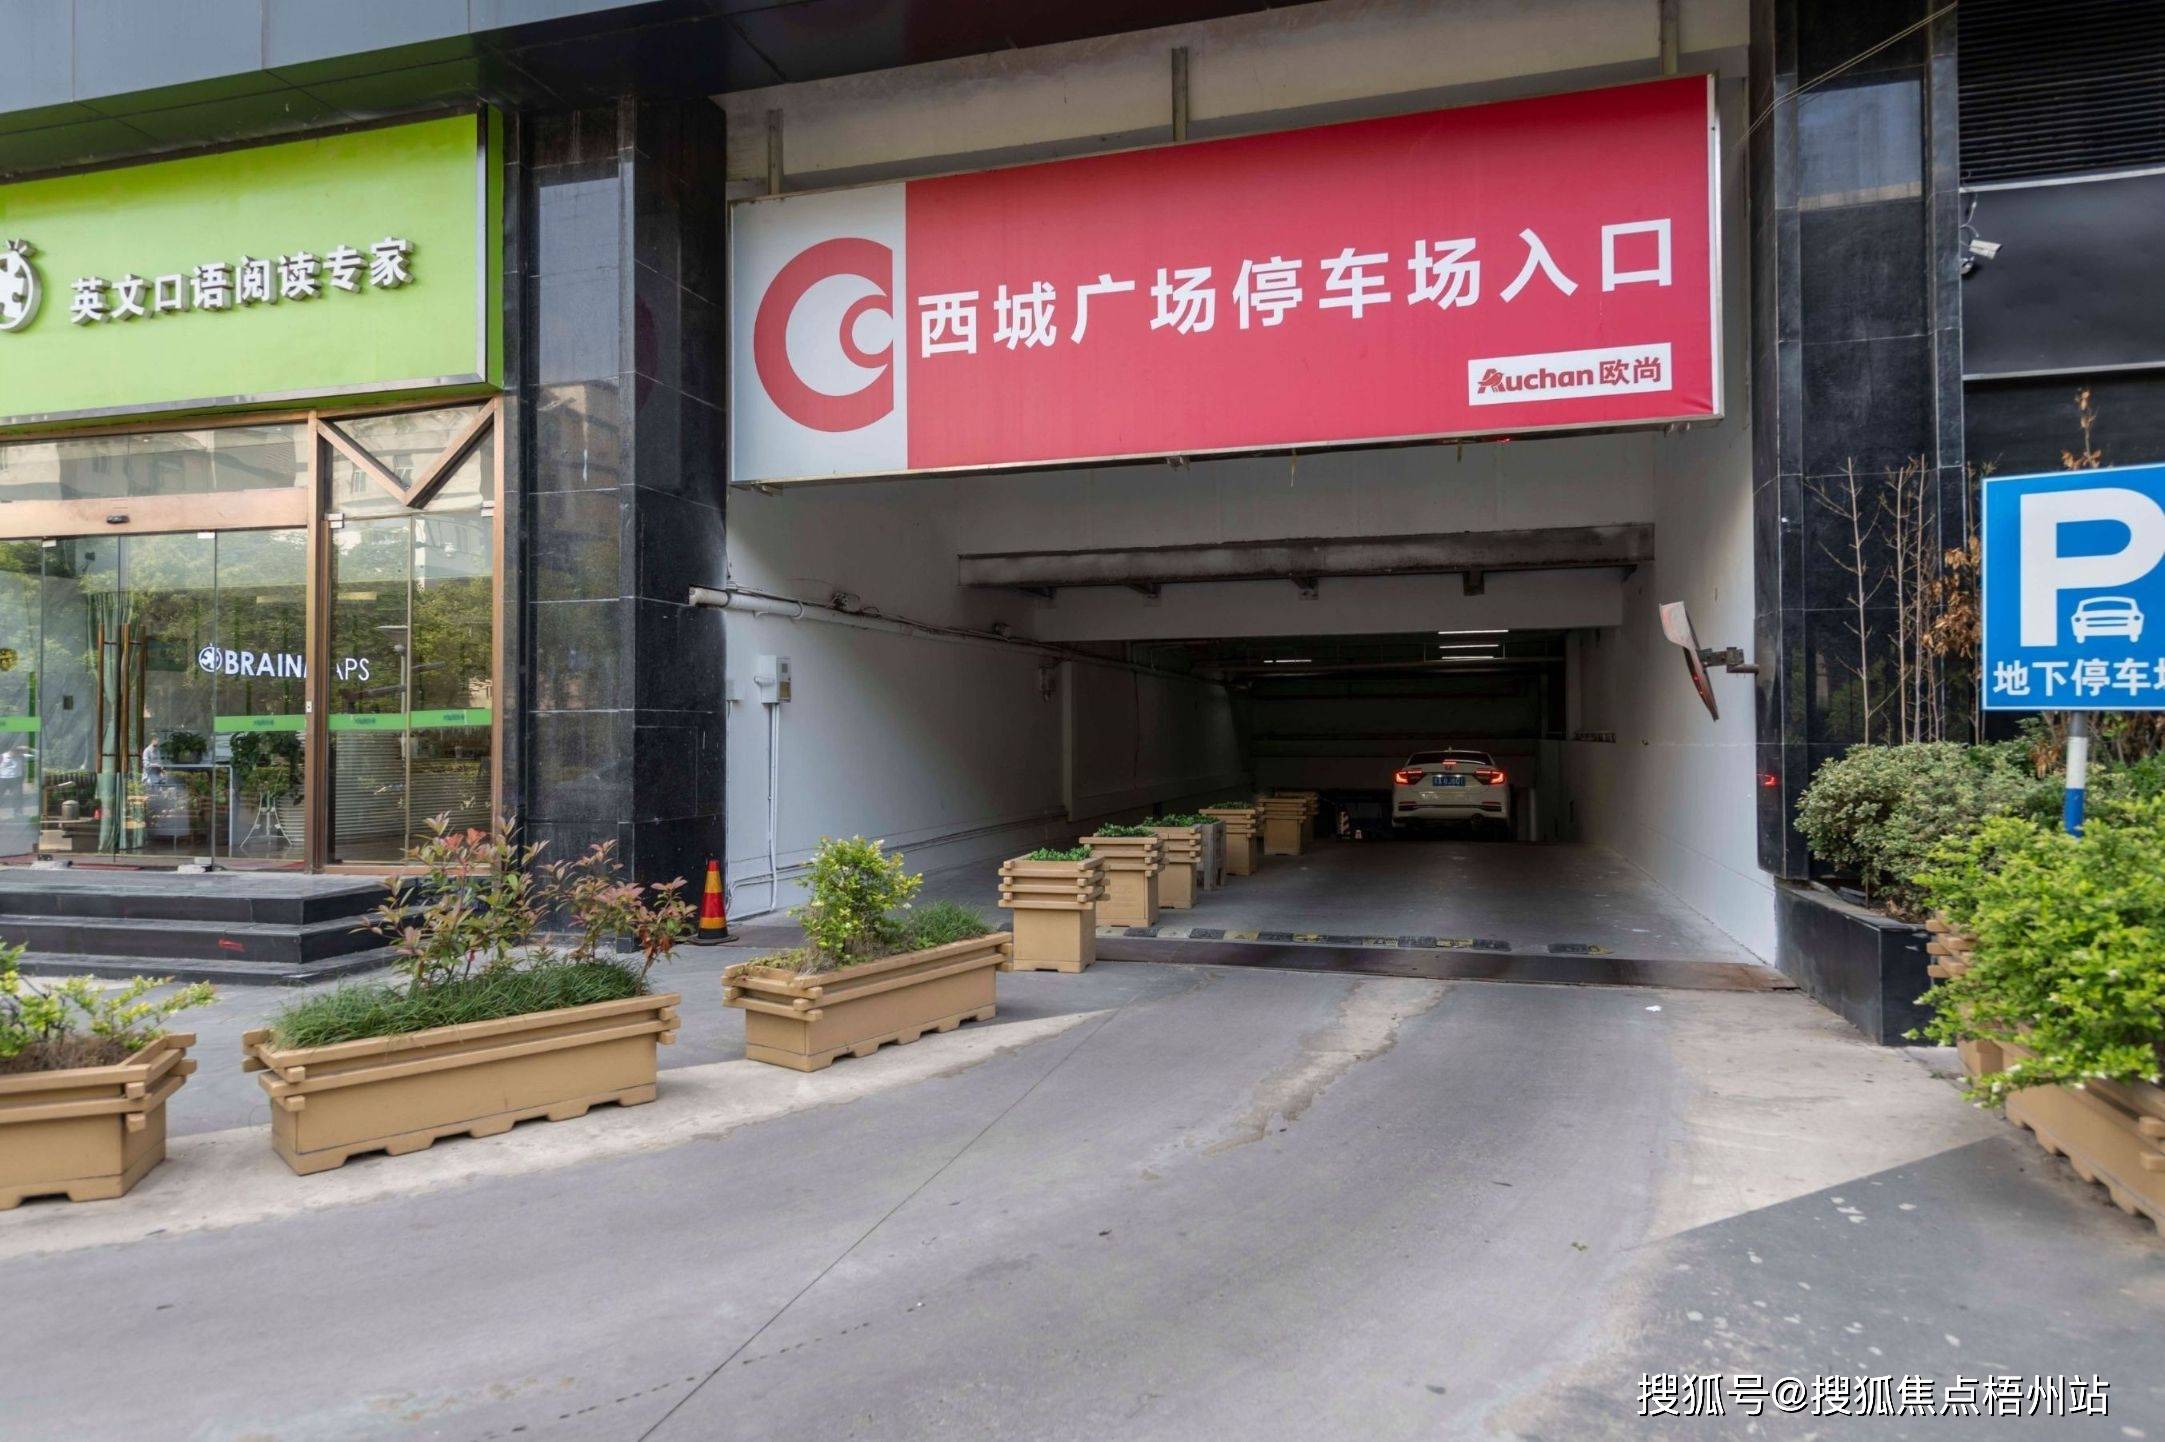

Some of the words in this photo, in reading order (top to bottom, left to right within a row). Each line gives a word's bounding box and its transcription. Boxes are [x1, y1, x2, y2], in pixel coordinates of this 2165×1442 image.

[70, 236, 415, 326] 英文口语阅读专家
[918, 217, 1673, 359] 西城广场停车场入口
[1477, 367, 1594, 394] Auchan
[1599, 356, 1662, 386] 欧尚
[2020, 487, 2165, 648] P
